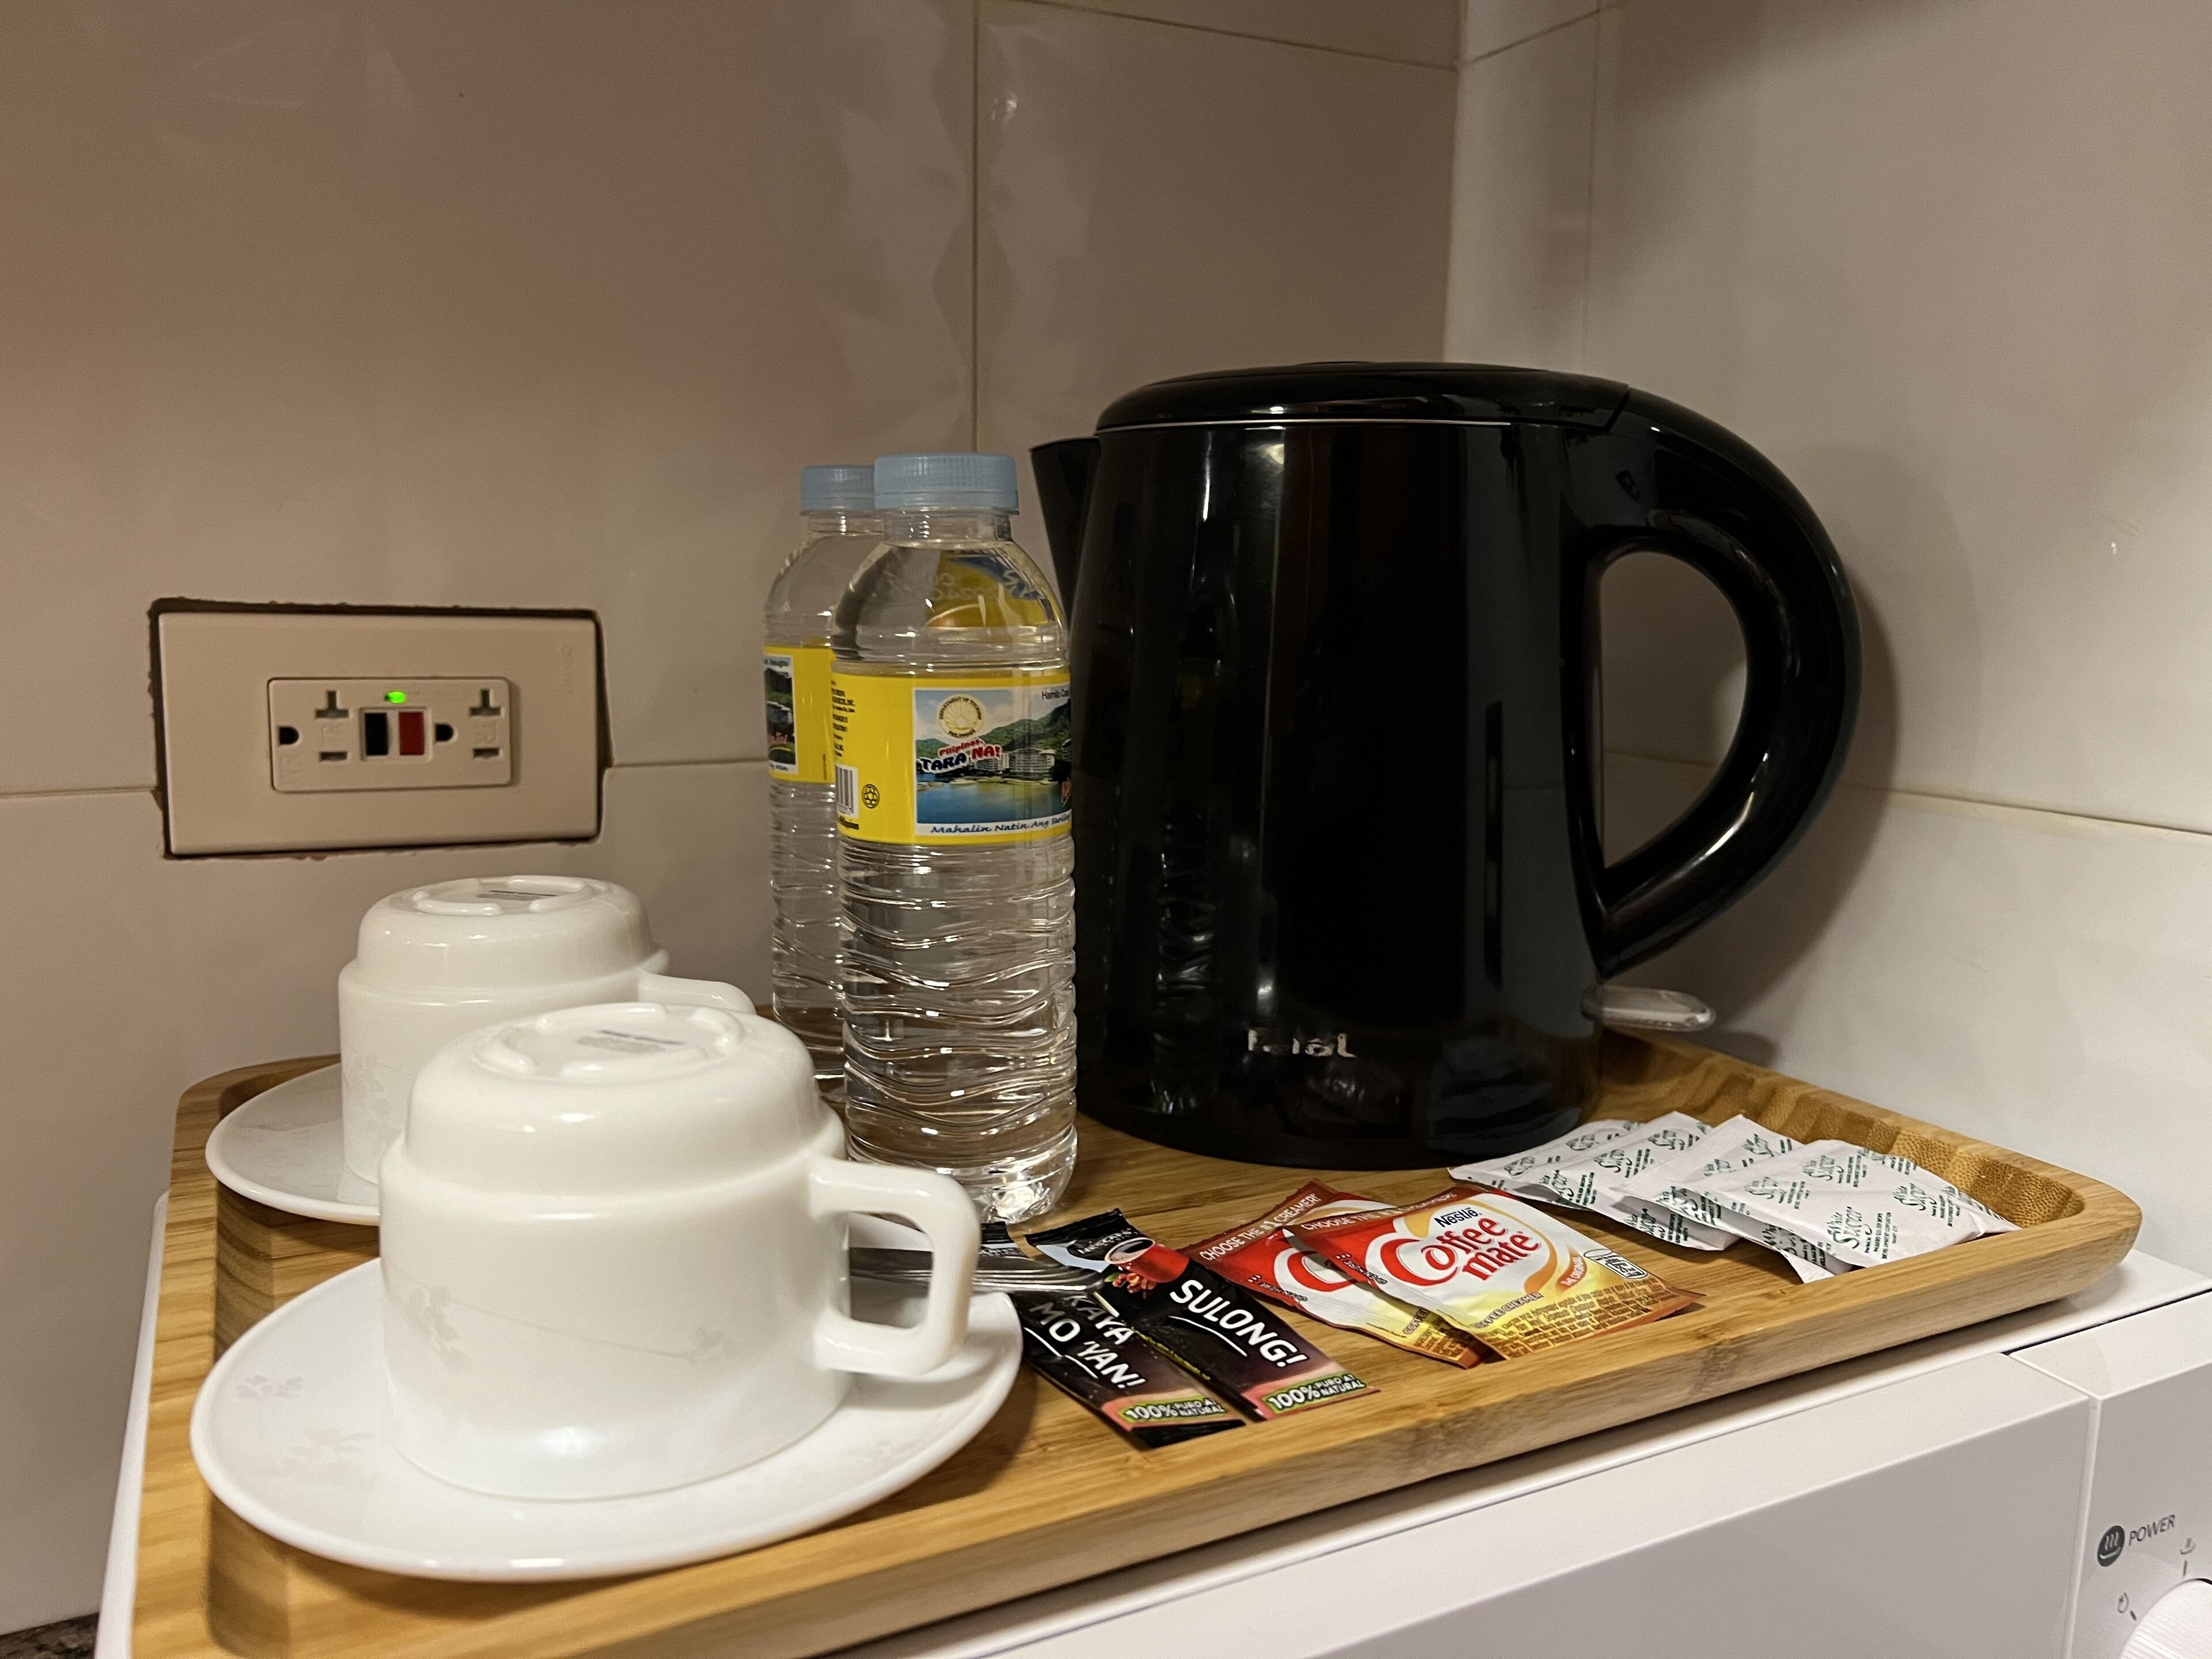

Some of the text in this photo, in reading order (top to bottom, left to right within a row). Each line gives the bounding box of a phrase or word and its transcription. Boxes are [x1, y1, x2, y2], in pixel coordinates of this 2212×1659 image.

[921, 745, 1001, 771] TARA NA!
[930, 824, 992, 834] Mahalin
[995, 822, 1029, 832] Natin
[1031, 820, 1049, 828] Ang
[1199, 1236, 1245, 1261] CHOOSE
[1240, 1228, 1264, 1244] THE
[1274, 1193, 1322, 1222] CREAMER!
[1301, 1215, 1356, 1230] CHOOSE
[1434, 1207, 1479, 1228] Nestlé
[1826, 1211, 1843, 1236] White
[1832, 1206, 1873, 1249] Sugar
[1380, 1218, 1506, 1286] Coffee
[1462, 1233, 1540, 1281] mate
[1502, 1291, 1544, 1312] CREAMER
[1029, 1302, 1081, 1342] MO
[1062, 1295, 1135, 1346] KAYA
[1169, 1278, 1309, 1368] SULONG!
[1268, 1373, 1356, 1410] 100% PURO AT
[1319, 1381, 1365, 1397] NATURAL
[1125, 1402, 1179, 1421] 100%
[1179, 1407, 1225, 1416] NATURAL
[2129, 1514, 2175, 1546] POWER
